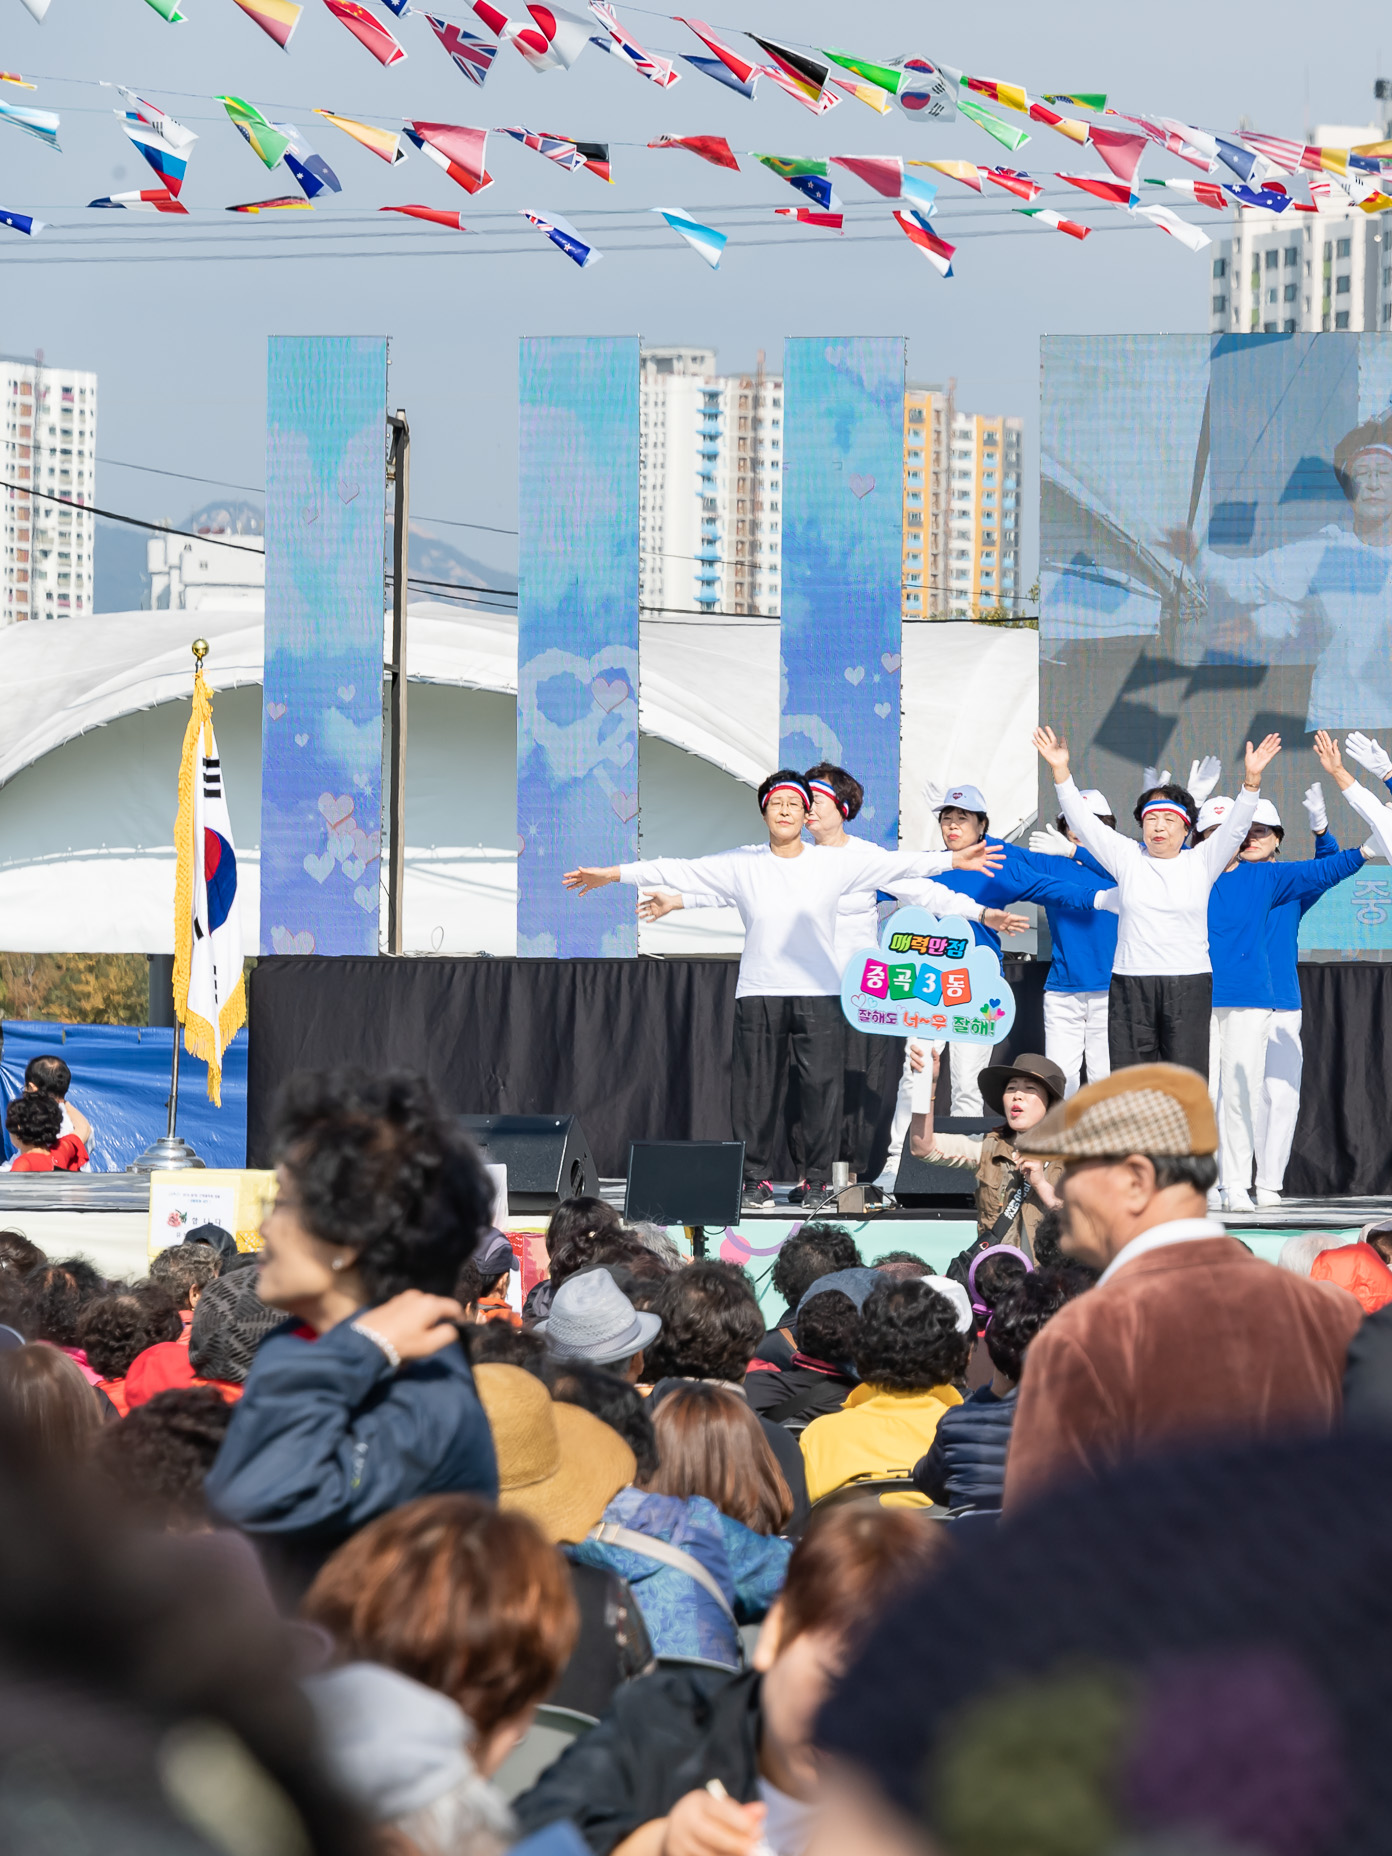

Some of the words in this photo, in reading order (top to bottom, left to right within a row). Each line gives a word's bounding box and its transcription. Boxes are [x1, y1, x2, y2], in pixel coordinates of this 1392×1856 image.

[889, 933, 968, 959] 매력만점
[865, 963, 967, 1000] 중곡3동
[858, 1008, 898, 1025] 잘해도
[952, 1015, 996, 1037] 잘해!
